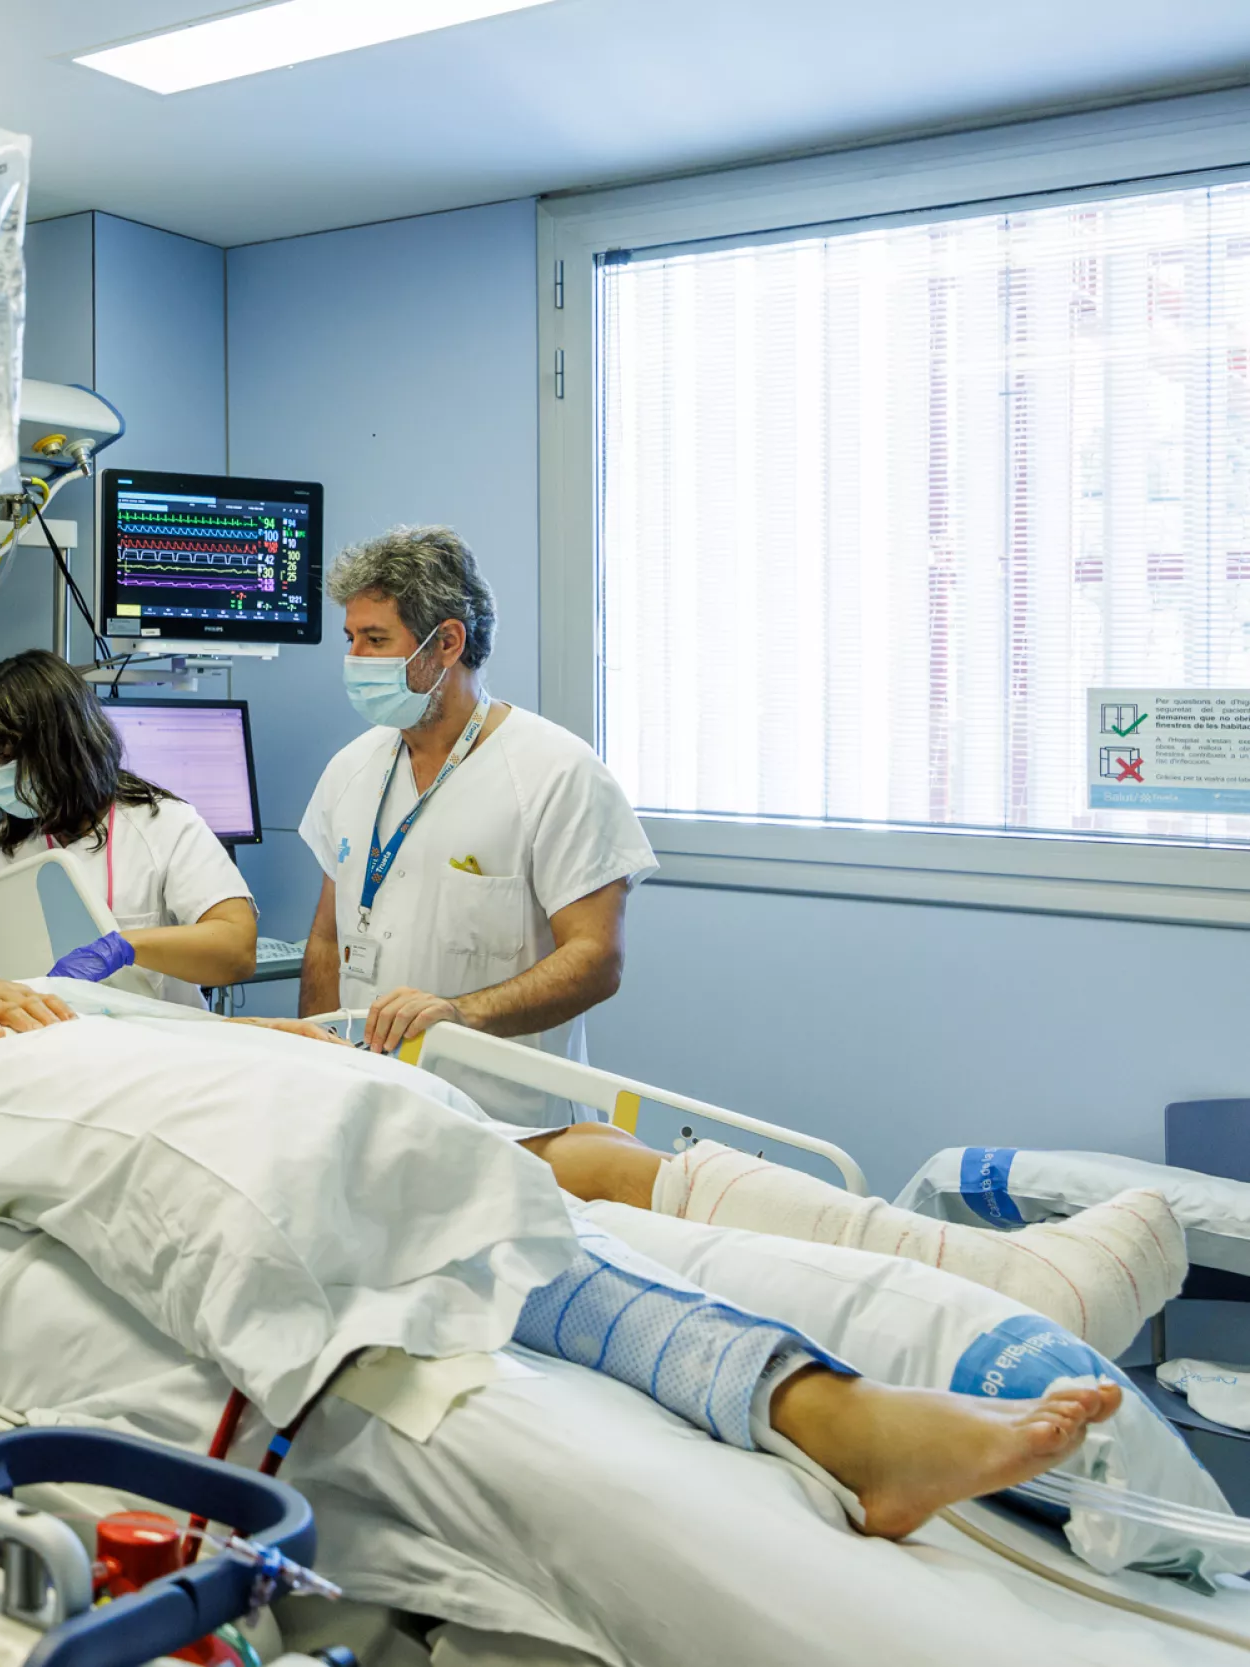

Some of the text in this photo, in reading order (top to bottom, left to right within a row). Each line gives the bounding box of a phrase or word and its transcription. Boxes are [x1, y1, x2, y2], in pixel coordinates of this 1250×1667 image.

[264, 517, 275, 529] 94
[264, 530, 279, 541] 100
[264, 554, 275, 565] 42
[288, 550, 301, 561] 100
[287, 561, 297, 571] 26
[262, 567, 274, 579] 30
[287, 571, 297, 582] 25
[1155, 706, 1192, 714] seguretat
[1155, 713, 1196, 721] demanem
[1199, 714, 1216, 722] que
[1155, 721, 1250, 731] finestres de les habitac
[981, 1369, 1007, 1397] de
